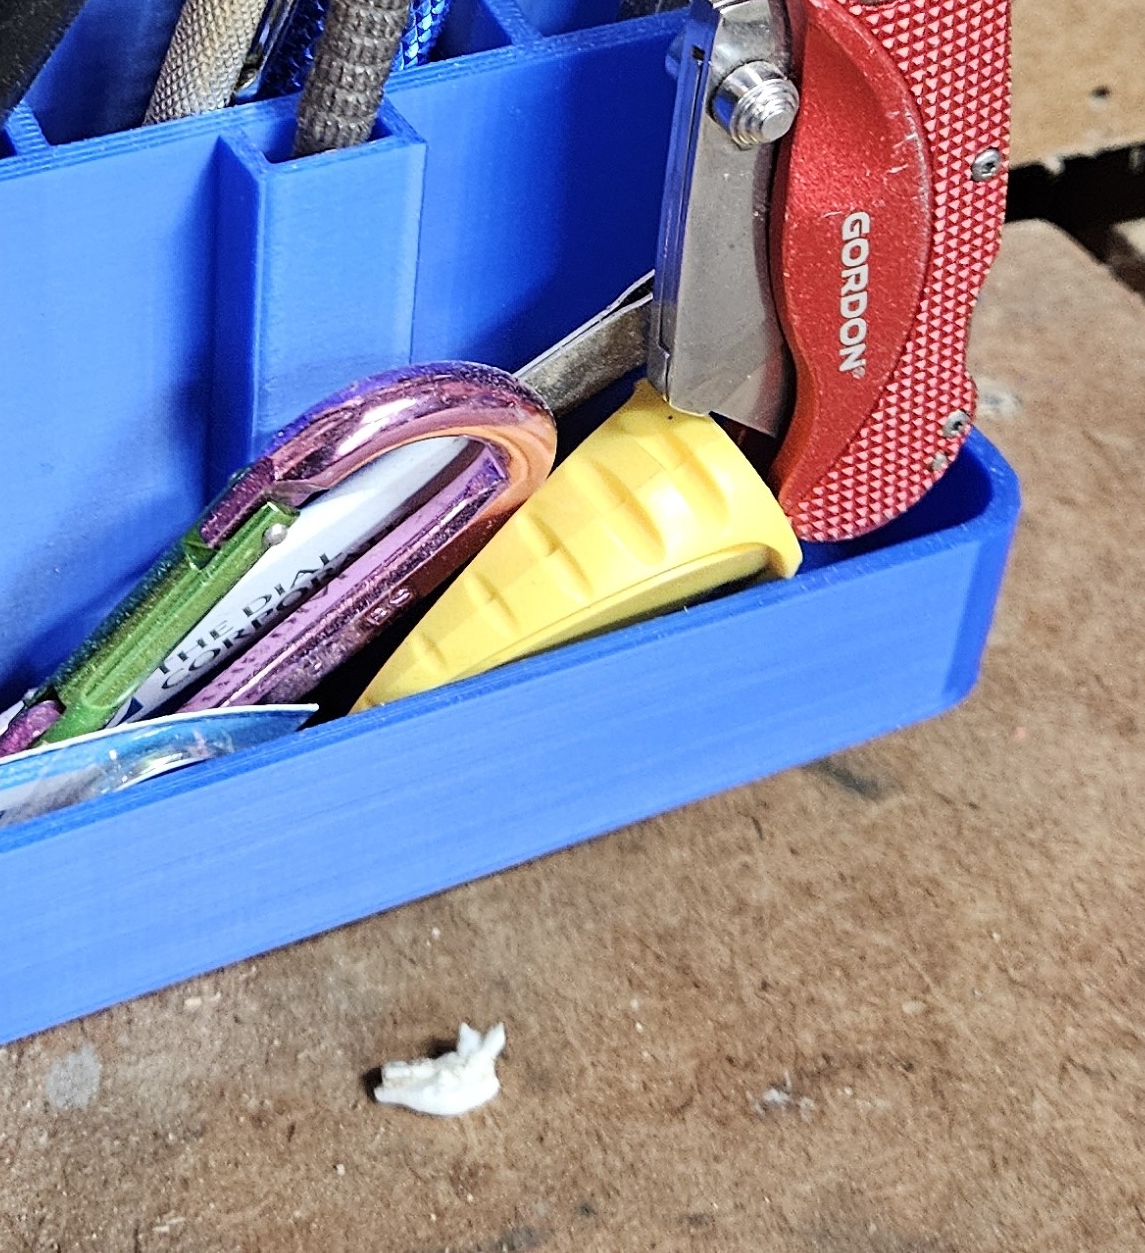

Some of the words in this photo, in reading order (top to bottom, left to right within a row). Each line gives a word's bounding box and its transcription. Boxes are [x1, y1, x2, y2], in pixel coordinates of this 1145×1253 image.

[839, 211, 871, 372] GORDON
[158, 620, 234, 675] THE
[242, 552, 344, 617] DIAL
